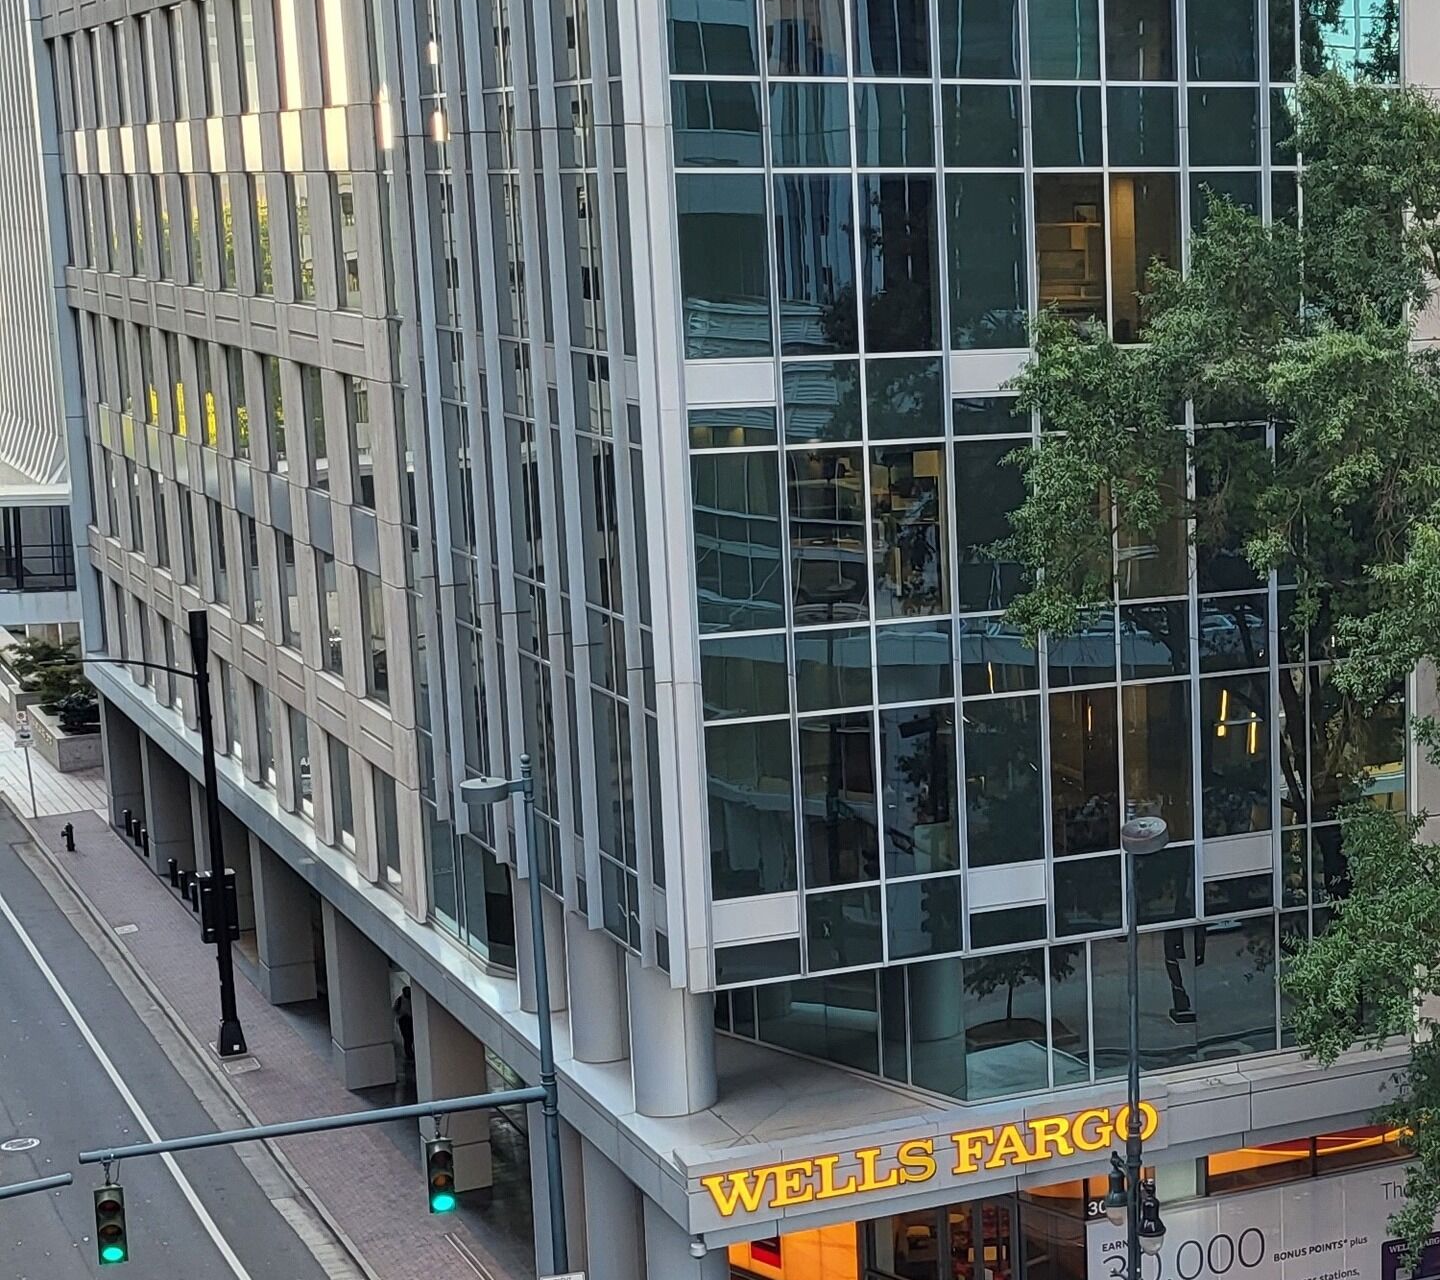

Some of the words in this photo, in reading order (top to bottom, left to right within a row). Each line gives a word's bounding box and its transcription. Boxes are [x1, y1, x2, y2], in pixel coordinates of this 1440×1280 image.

[701, 1138, 937, 1217] WELLS
[951, 1099, 1159, 1175] FARGO
[1273, 1247, 1307, 1262] BONUS
[1349, 1235, 1368, 1248] plus
